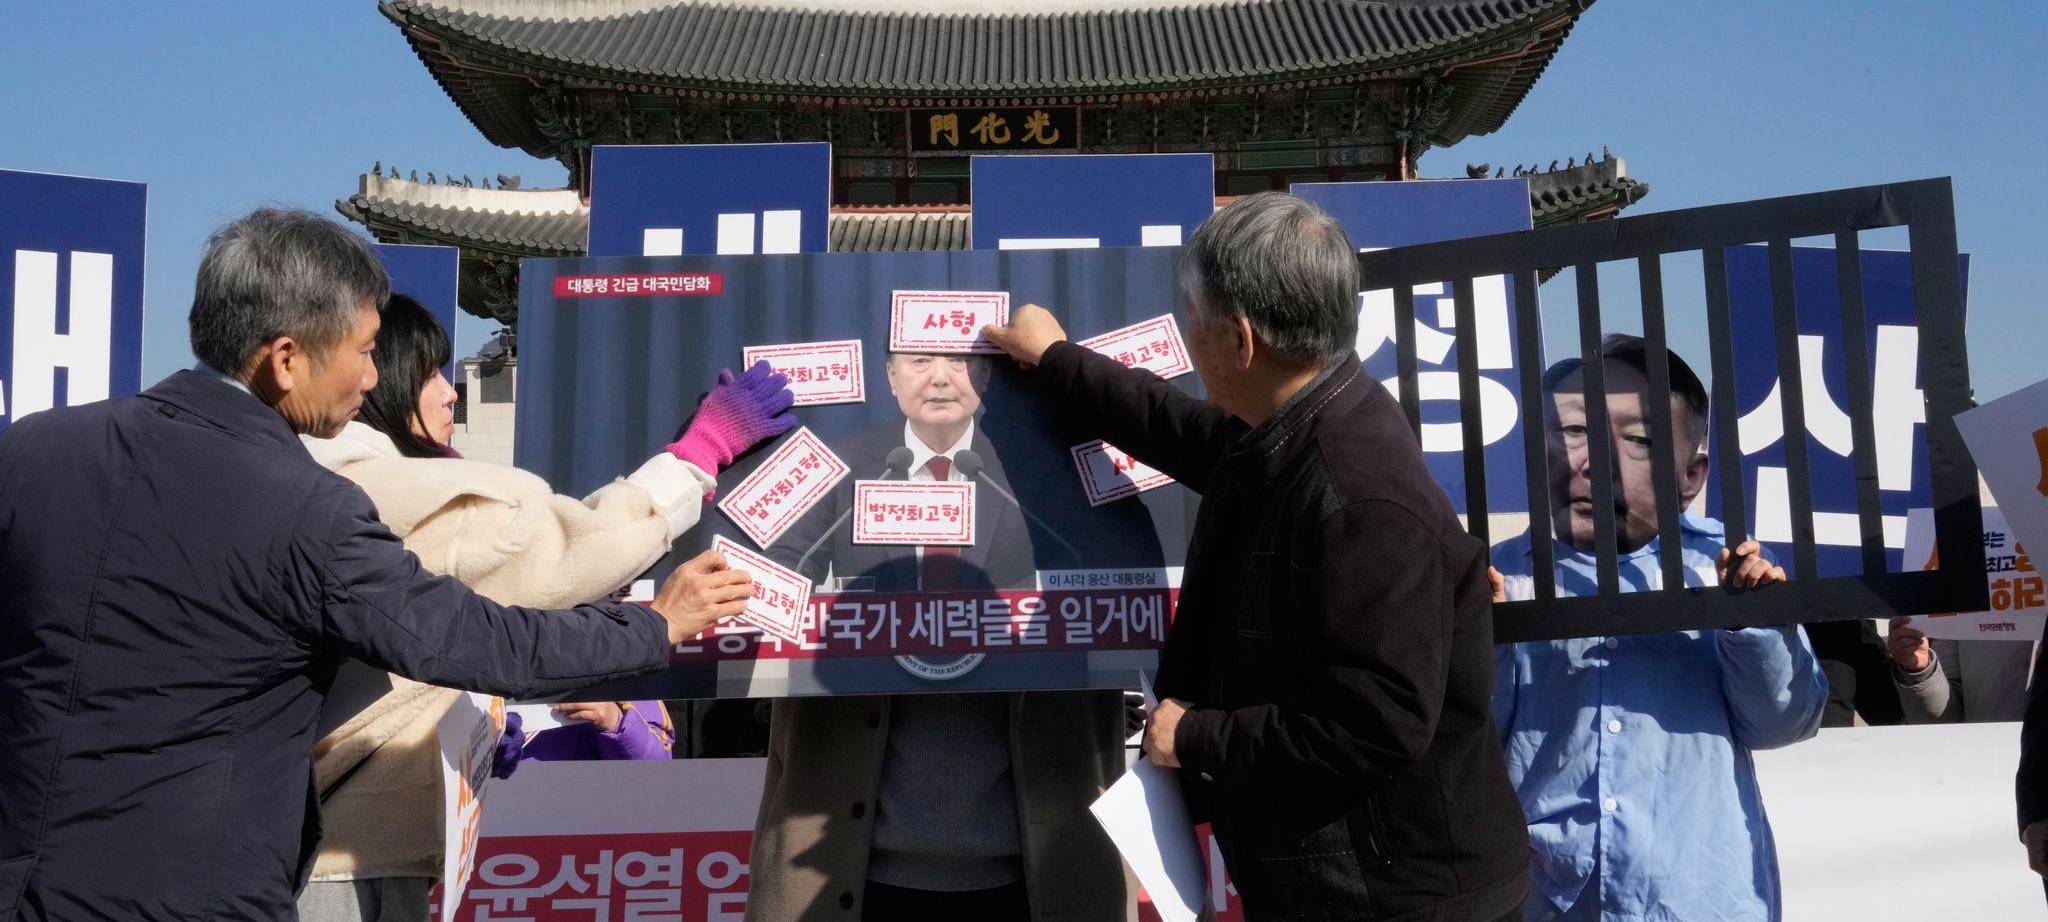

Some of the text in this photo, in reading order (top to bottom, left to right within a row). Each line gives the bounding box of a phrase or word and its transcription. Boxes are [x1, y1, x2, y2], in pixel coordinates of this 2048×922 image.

[567, 275, 711, 293] 대통령 긴급 대국민담화
[923, 310, 975, 335] 사형
[746, 452, 820, 520] 법정최고형
[869, 503, 960, 522] 법정최고형
[1049, 571, 1155, 588] 이 시각 용산 대통령실
[750, 579, 796, 615] 최고형
[800, 600, 902, 651] 반국가
[908, 596, 1051, 648] 세력들을
[1059, 594, 1165, 644] 일거에
[468, 847, 684, 922] 윤석열
